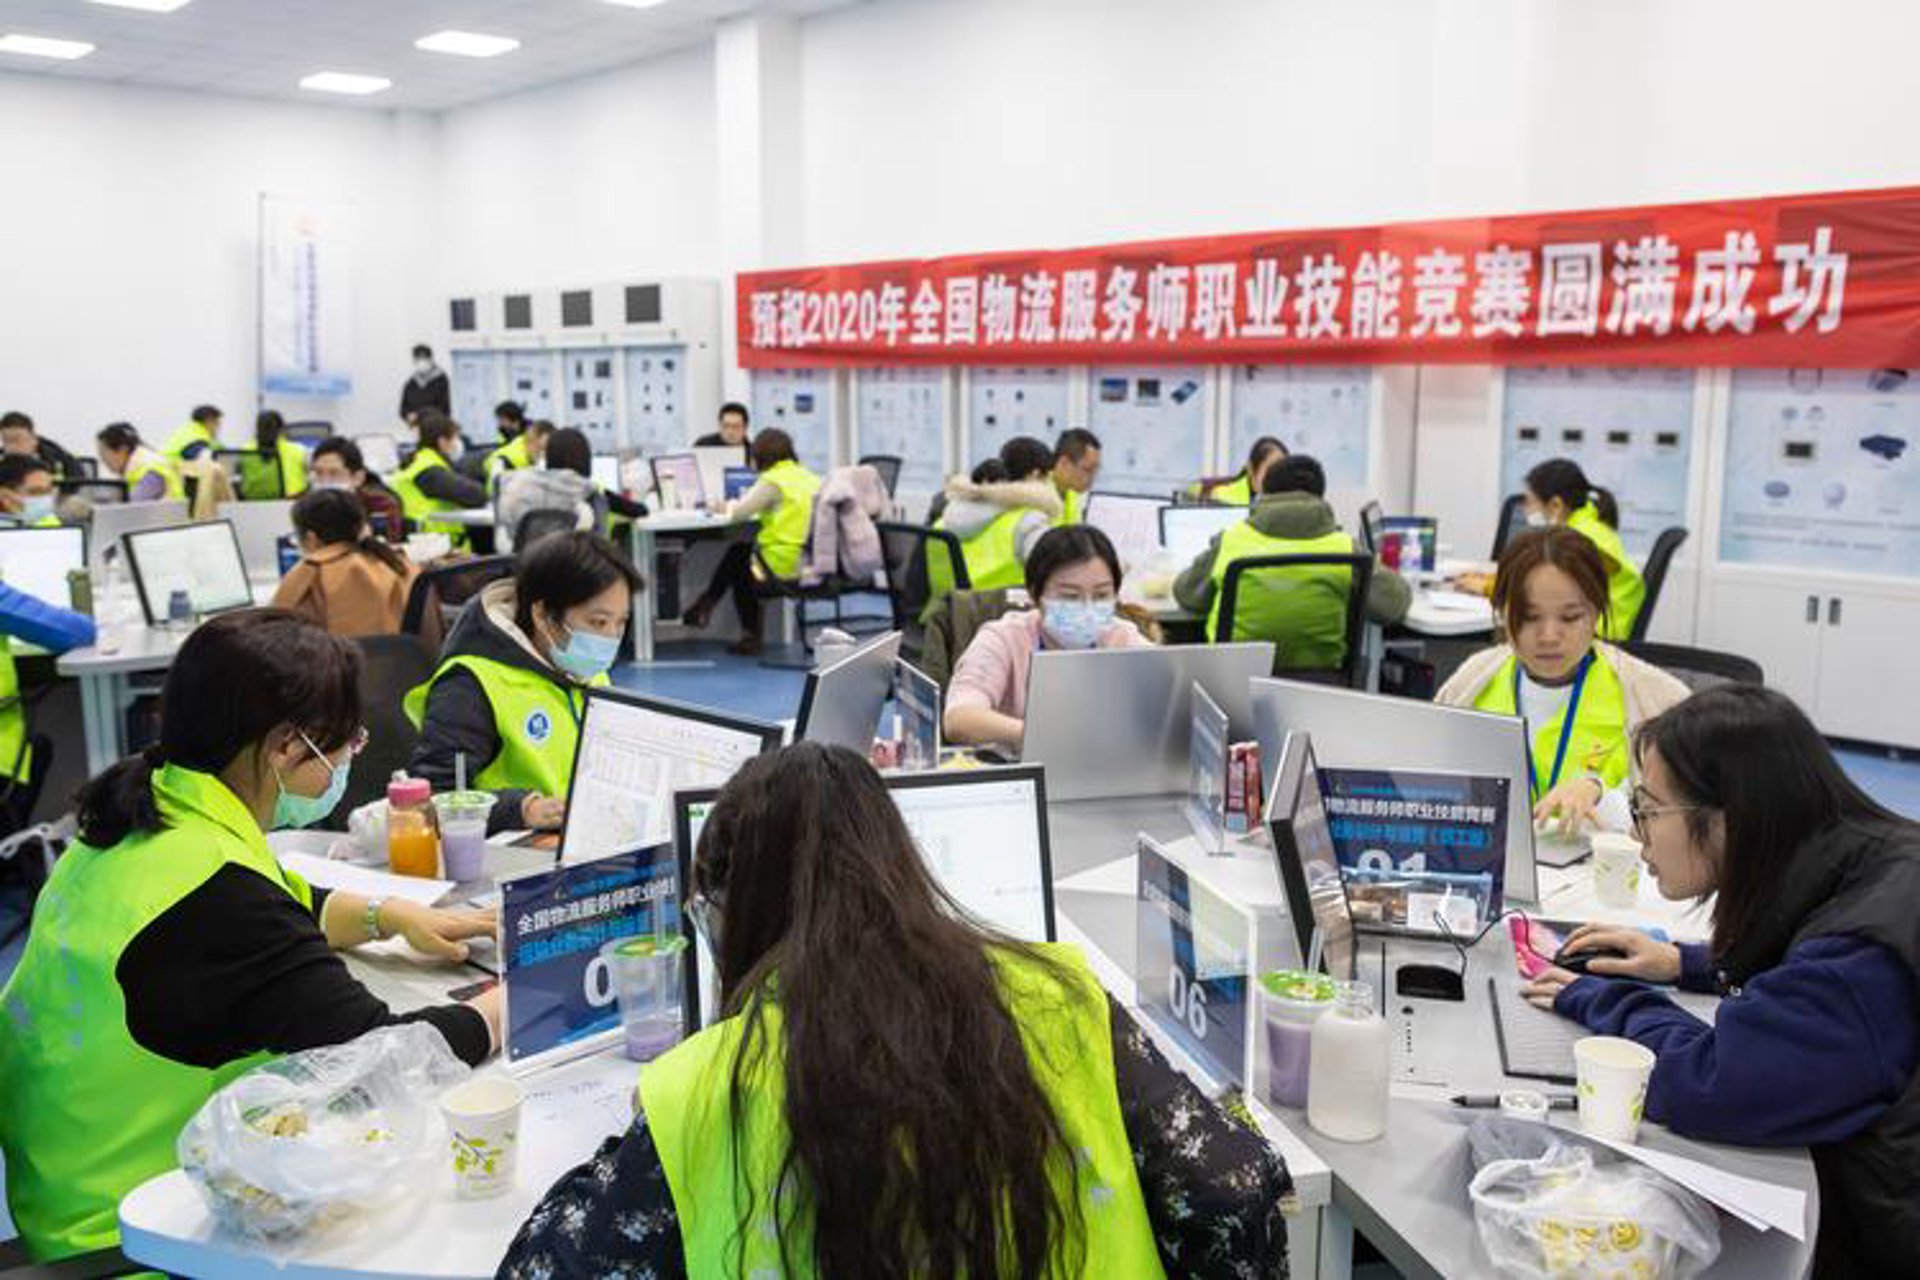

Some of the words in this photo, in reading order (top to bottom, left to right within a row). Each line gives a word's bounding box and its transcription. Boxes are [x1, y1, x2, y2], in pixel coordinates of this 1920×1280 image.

[750, 225, 1849, 348] 预祝2020年全国物流服务师职业技能竞赛圆满成功
[1326, 798, 1496, 823] 物流服务师职业技能竞赛
[1169, 966, 1207, 1039] 06
